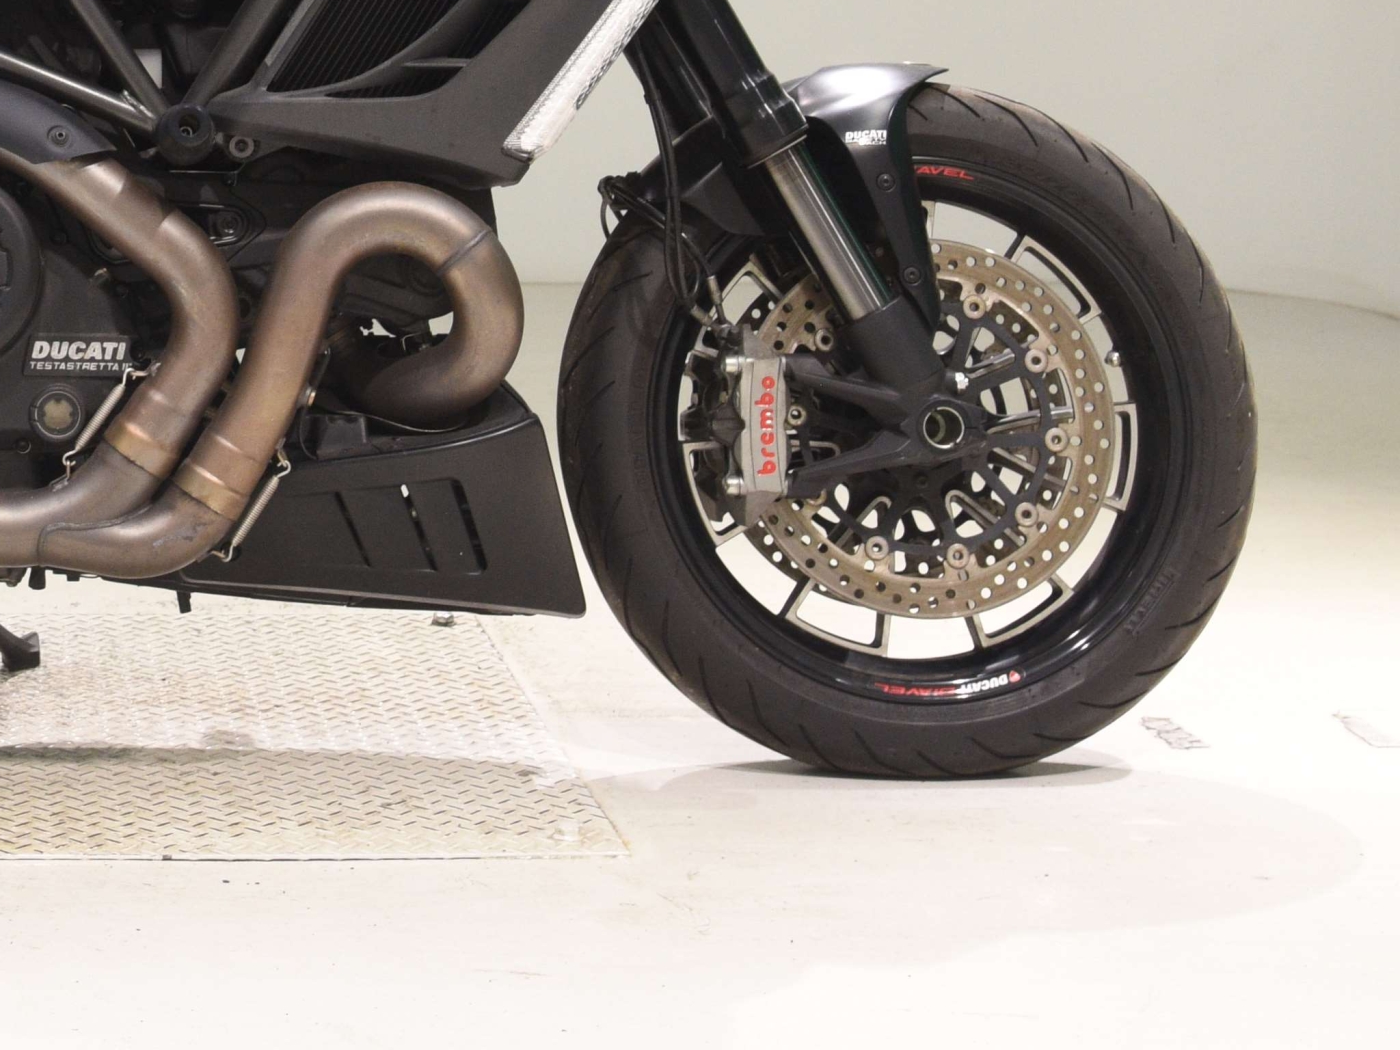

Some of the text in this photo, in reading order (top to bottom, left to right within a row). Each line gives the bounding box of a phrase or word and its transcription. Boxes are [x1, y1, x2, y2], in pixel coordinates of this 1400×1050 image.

[845, 130, 887, 141] DUCATI
[914, 164, 974, 181] AVEL
[31, 340, 127, 360] DUCATI
[29, 361, 119, 371] TESTASTRETTA
[754, 375, 777, 476] brembo
